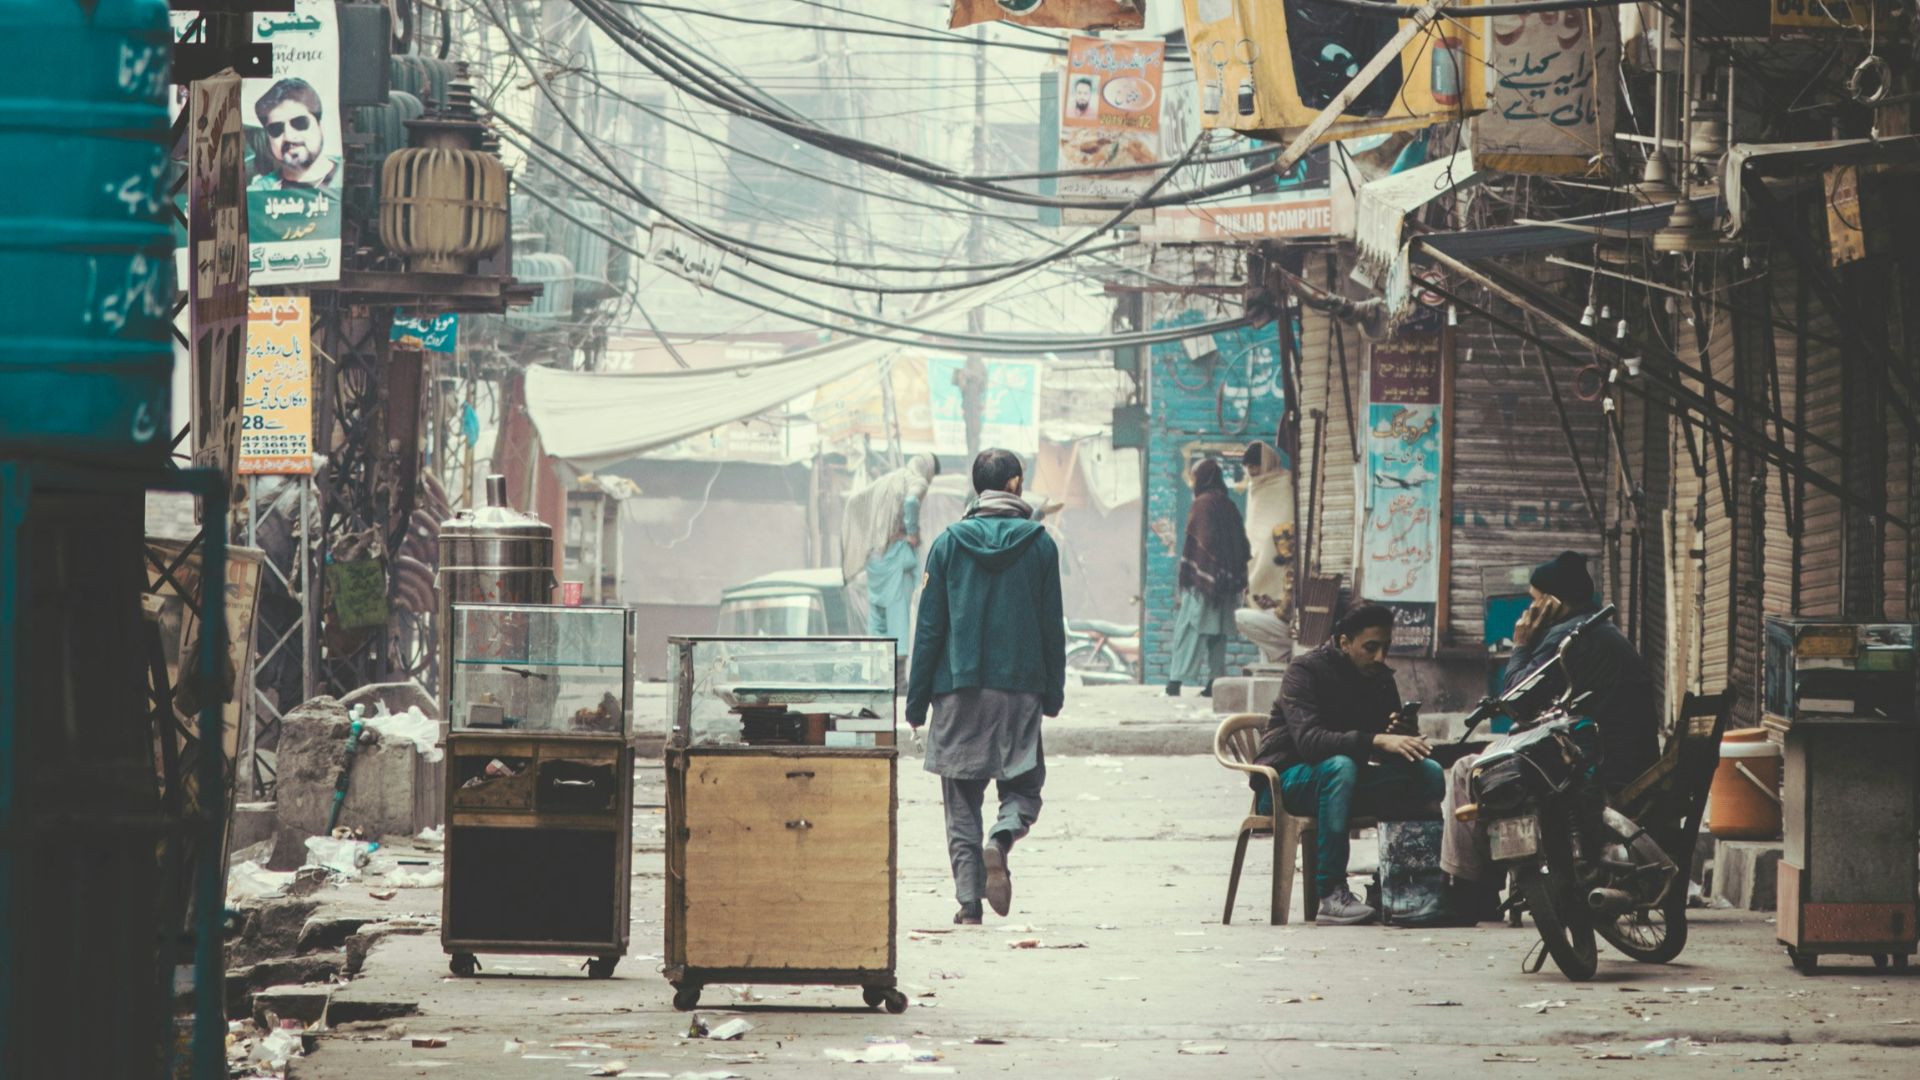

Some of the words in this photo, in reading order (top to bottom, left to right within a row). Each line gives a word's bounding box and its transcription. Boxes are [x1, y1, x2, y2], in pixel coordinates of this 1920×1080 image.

[257, 12, 322, 38] جشن
[273, 47, 322, 63] ndence
[275, 65, 289, 75] AY
[265, 197, 305, 220] محمود
[1215, 212, 1265, 235] PUNJAB
[1267, 206, 1331, 232] COMPUTE
[281, 222, 317, 241] صدر
[268, 247, 331, 271] خدمت
[242, 414, 264, 431] 28
